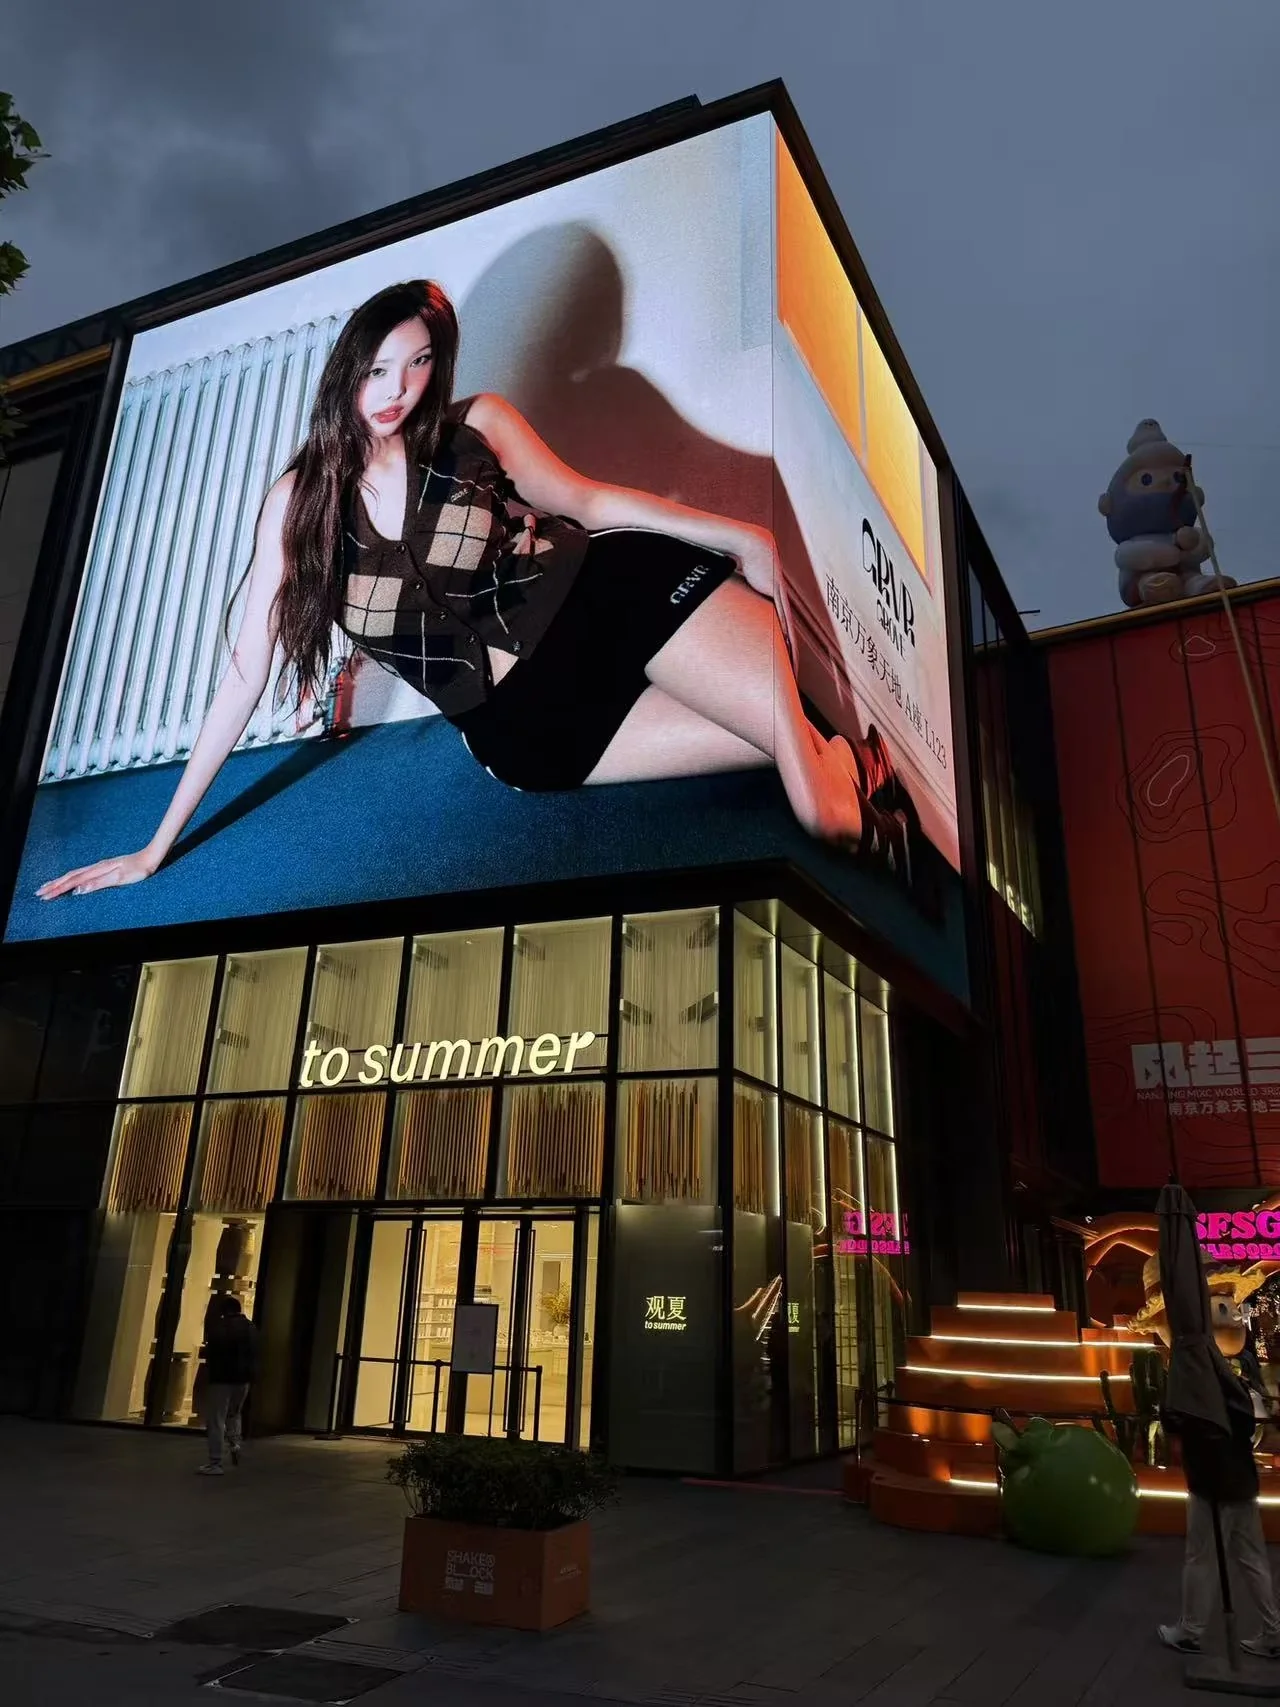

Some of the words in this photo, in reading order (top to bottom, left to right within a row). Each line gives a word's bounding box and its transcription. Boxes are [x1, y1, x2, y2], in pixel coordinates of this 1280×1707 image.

[825, 573, 903, 709] 南京万象天地
[925, 718, 947, 769] L123
[299, 1039, 350, 1088] to
[357, 1030, 596, 1085] summer
[1215, 1087, 1258, 1098] WORLD
[645, 1295, 687, 1320] 观夏
[645, 1320, 653, 1329] to
[653, 1322, 687, 1331] summer
